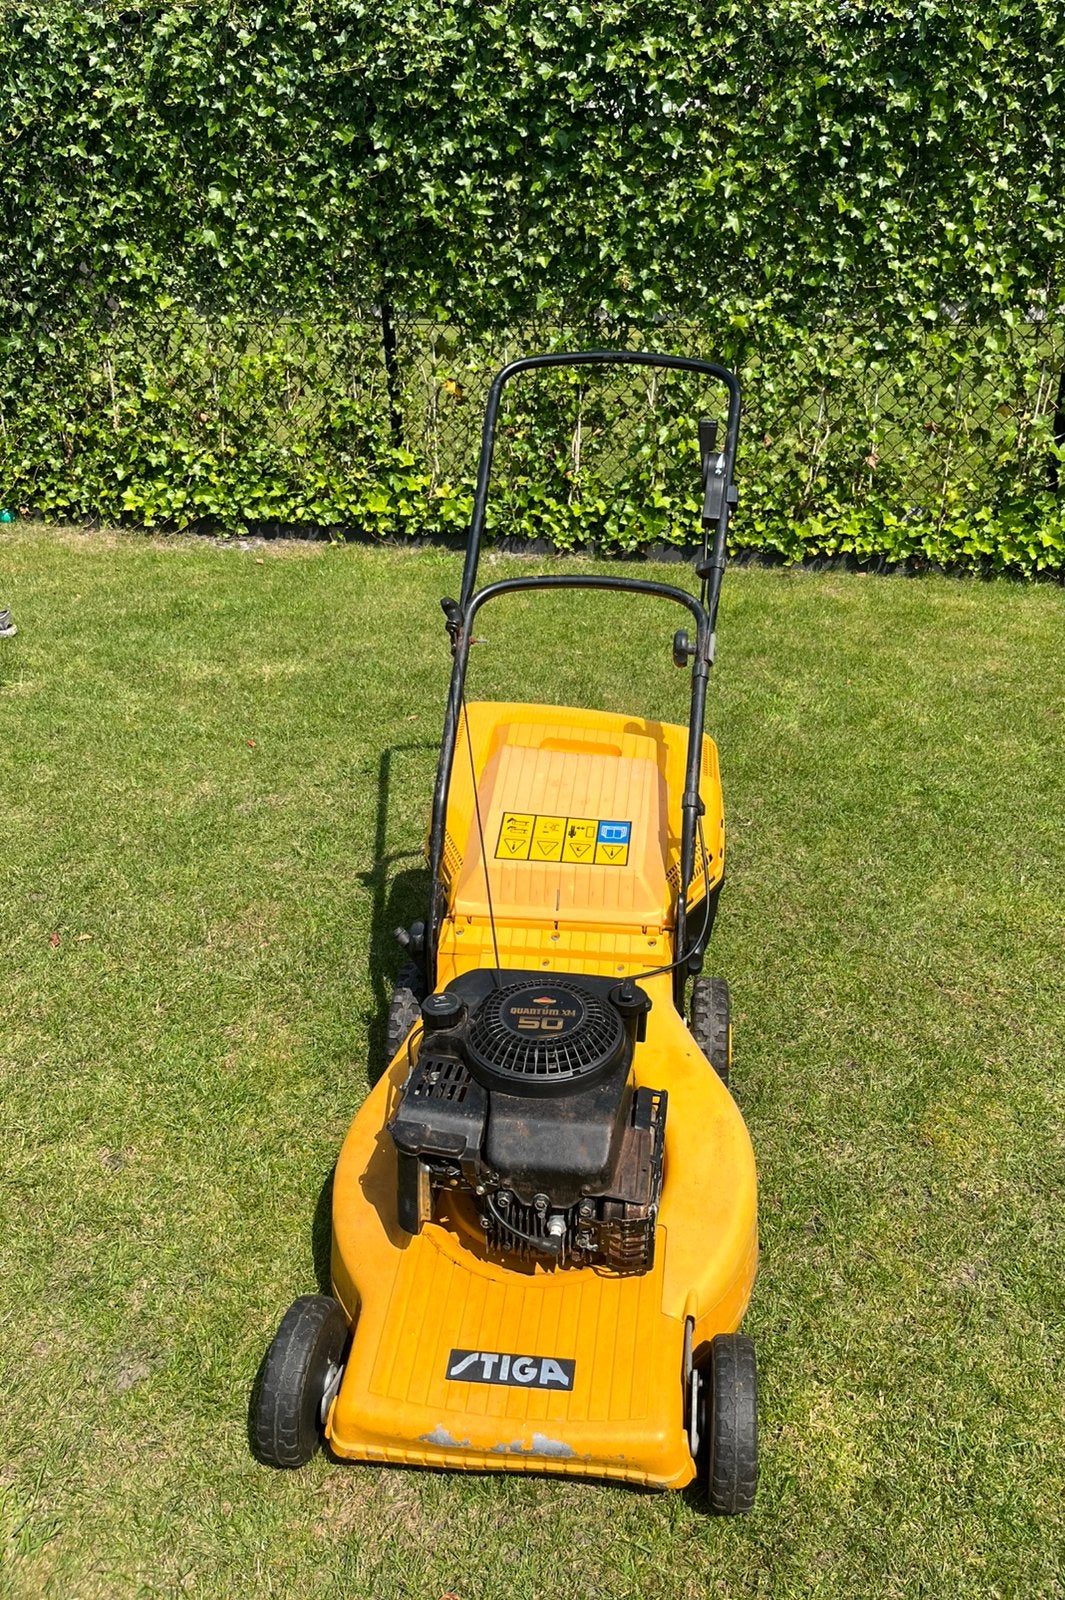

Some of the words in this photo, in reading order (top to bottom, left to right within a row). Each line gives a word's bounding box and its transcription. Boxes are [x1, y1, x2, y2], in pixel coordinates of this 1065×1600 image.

[510, 1007, 559, 1016] QUANTUM
[562, 1009, 576, 1017] XM
[517, 1015, 564, 1030] 50
[450, 1352, 570, 1386] STIGA
